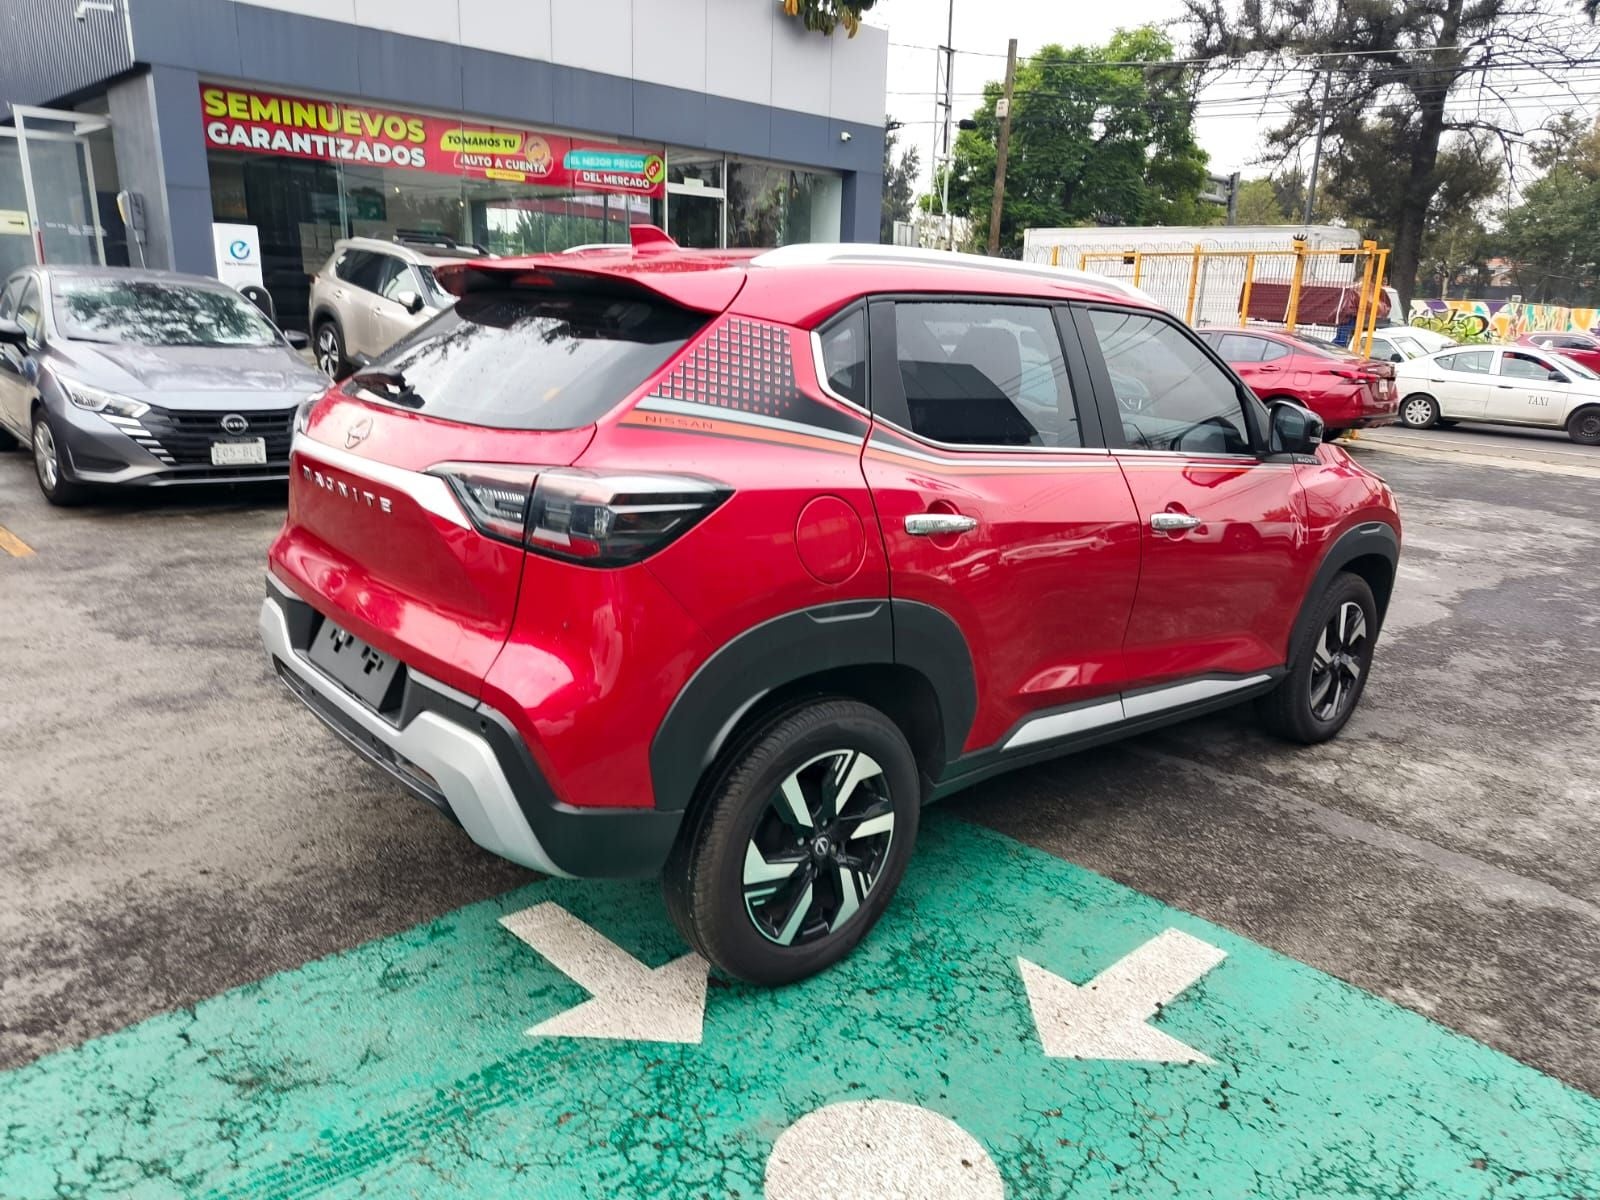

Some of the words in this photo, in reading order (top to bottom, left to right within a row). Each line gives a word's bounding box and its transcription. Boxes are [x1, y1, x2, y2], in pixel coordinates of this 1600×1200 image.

[203, 89, 427, 144] SEMINUEVOS
[207, 122, 426, 167] GARANTIZADOS
[448, 135, 500, 148] TOMAMOS
[502, 138, 516, 148] TU
[460, 154, 493, 167] AUTO
[494, 157, 503, 169] A
[505, 160, 547, 175] CUENTA
[570, 156, 580, 165] EL
[582, 156, 612, 168] MEJOR
[613, 158, 644, 169] PRECIO
[583, 171, 602, 183] DEL
[603, 173, 650, 188] MERCADO
[1527, 394, 1550, 407] TAXI
[645, 415, 713, 430] NISSAN
